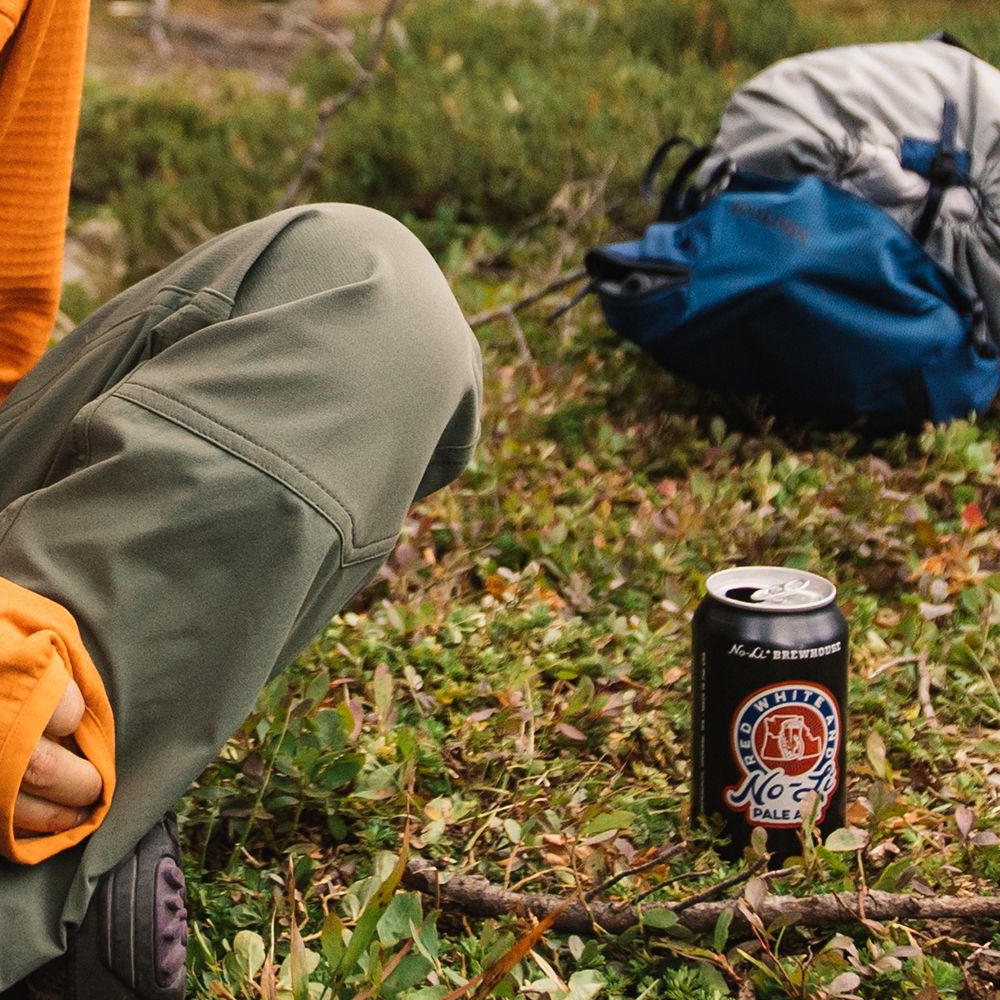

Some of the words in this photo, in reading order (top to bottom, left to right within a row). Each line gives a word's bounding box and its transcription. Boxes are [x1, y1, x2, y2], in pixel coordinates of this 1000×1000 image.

[773, 641, 842, 660] BREWHOUSE
[740, 722, 756, 766] RED
[753, 689, 826, 712] WHITE
[825, 714, 837, 759] AND
[753, 807, 791, 820] PALE
